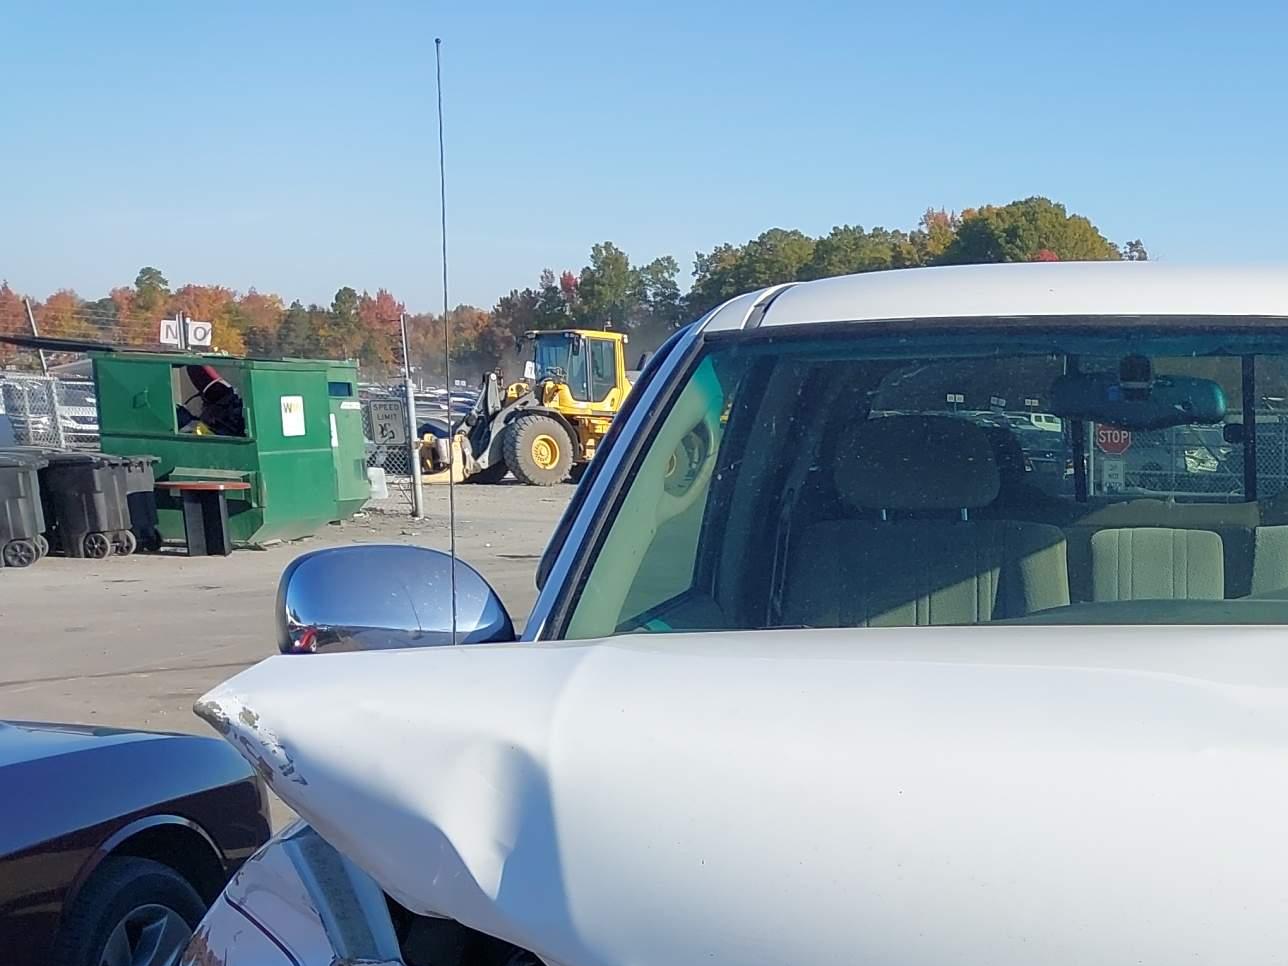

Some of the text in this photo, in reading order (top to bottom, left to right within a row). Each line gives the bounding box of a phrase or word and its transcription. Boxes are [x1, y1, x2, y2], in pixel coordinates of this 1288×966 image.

[373, 403, 400, 411] SPEED
[377, 413, 398, 421] LIMIT
[1098, 430, 1129, 443] STOP
